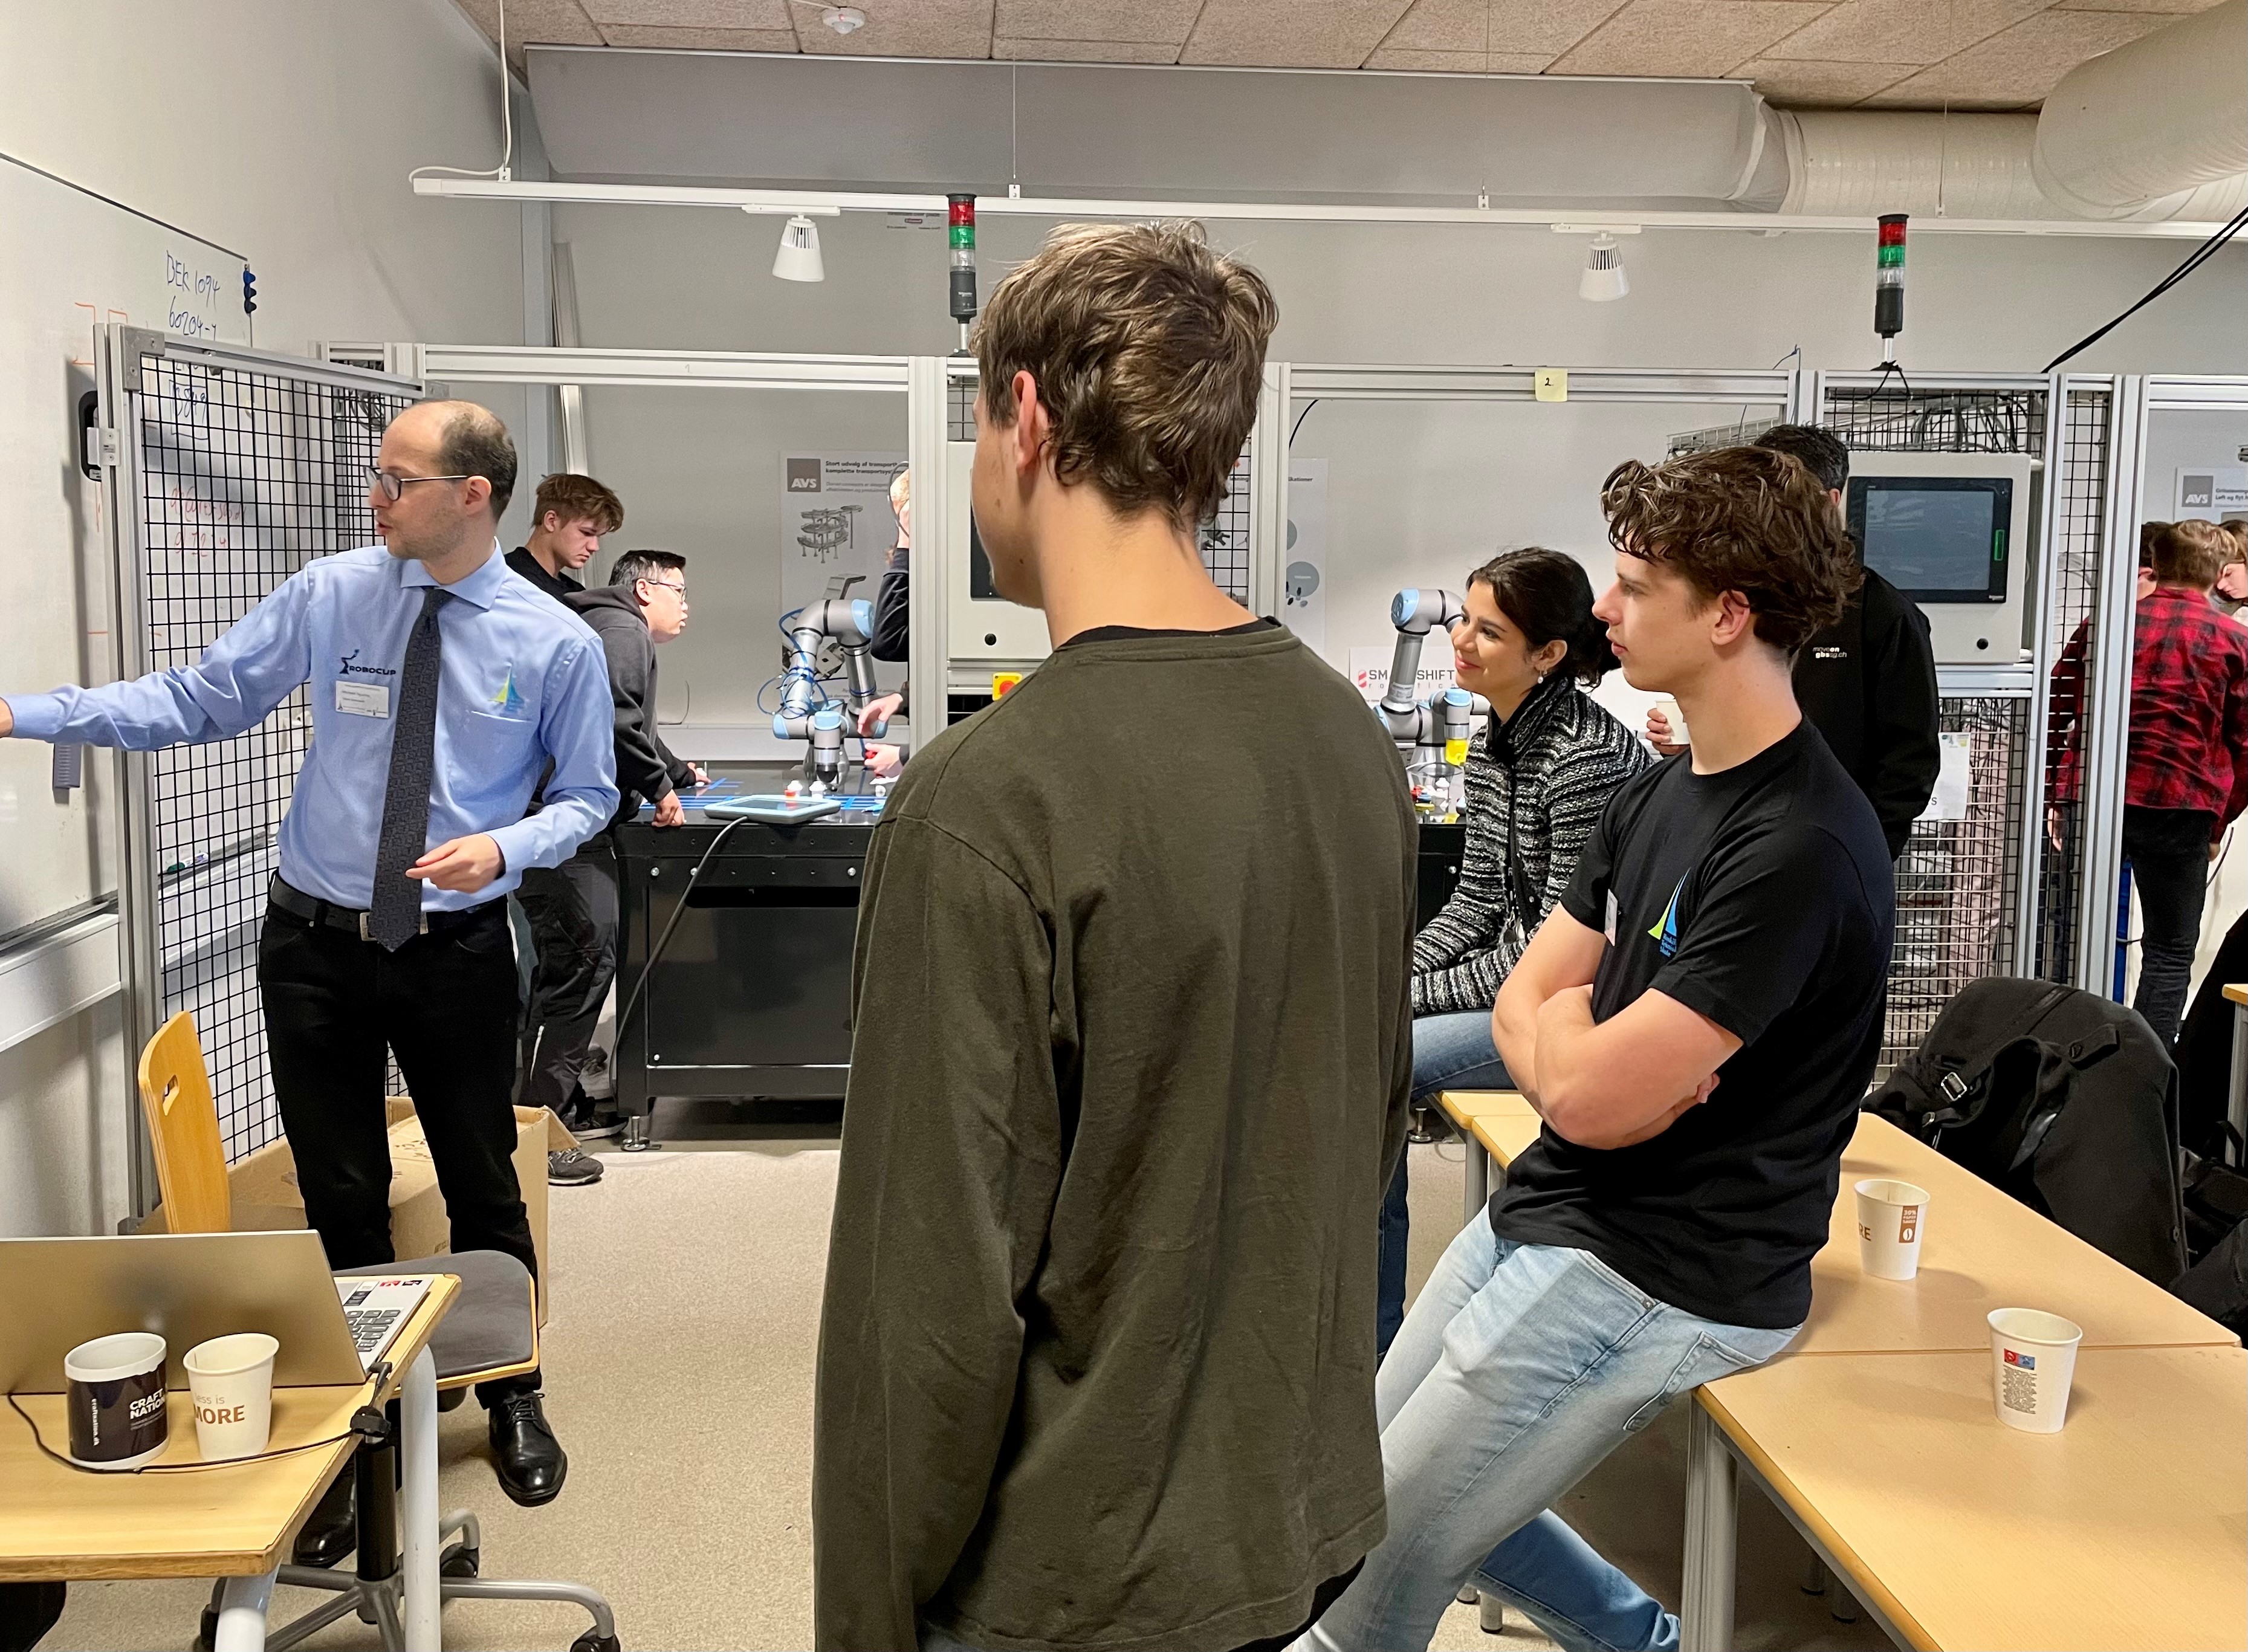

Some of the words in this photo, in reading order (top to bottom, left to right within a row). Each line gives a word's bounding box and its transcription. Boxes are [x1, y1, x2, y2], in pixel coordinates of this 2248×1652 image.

[195, 270, 221, 312] 1094
[791, 478, 817, 488] AVS
[2185, 494, 2208, 504] AVS
[349, 666, 396, 675] ROBOCUP
[129, 1388, 163, 1410] CRAFT
[216, 1394, 225, 1404] is
[130, 1395, 165, 1419] NATION
[193, 1404, 245, 1424] MORE
